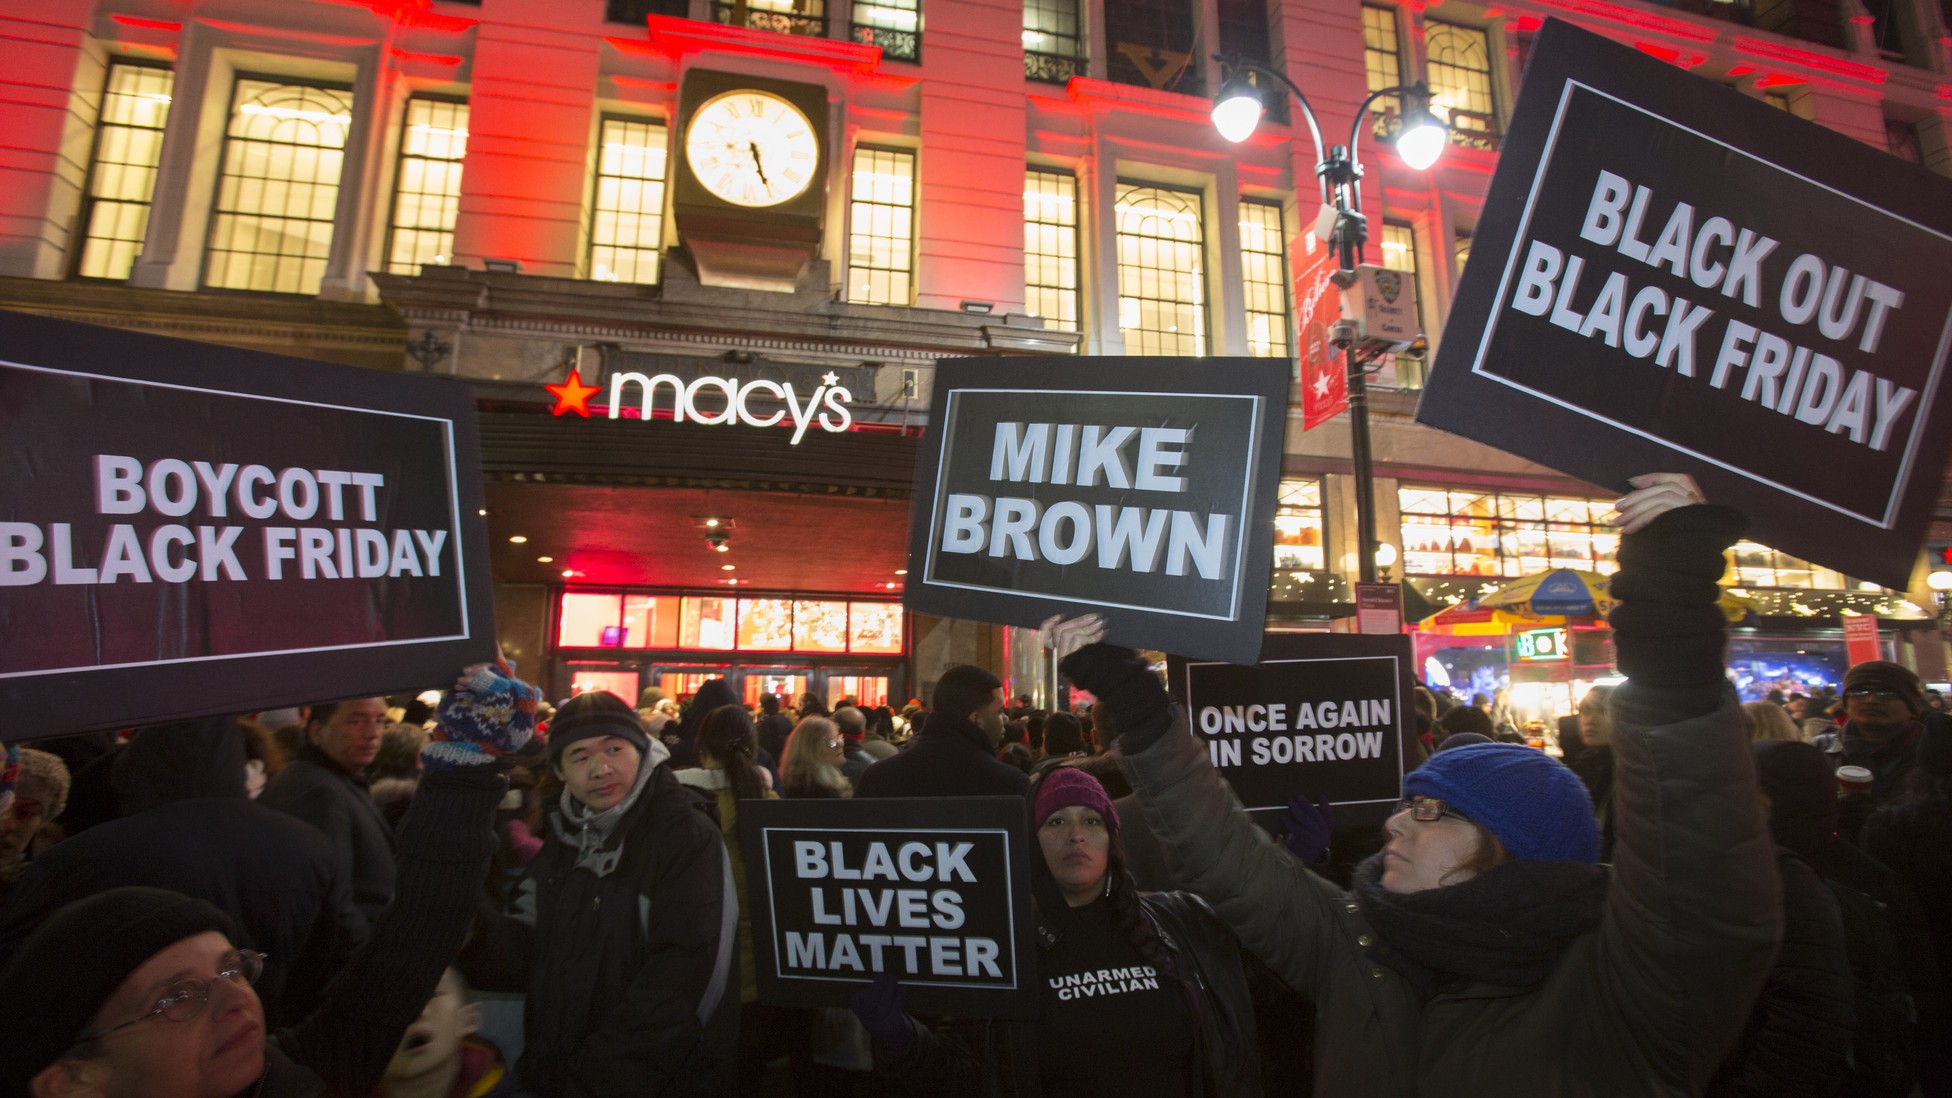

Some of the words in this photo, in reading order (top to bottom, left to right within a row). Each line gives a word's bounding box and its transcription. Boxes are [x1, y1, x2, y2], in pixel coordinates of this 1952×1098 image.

[1580, 169, 1780, 308] BLACK
[1779, 253, 1905, 353] OUT
[1512, 240, 1714, 378] BLACK
[1709, 319, 1917, 451] FRIDAY
[989, 421, 1192, 492] MIKE
[93, 454, 384, 522] BOYCOTT
[0, 521, 248, 586] BLACK
[262, 526, 448, 580] FRIDAY
[941, 493, 1230, 580] BROWN
[1200, 704, 1287, 735] ONCE
[1295, 699, 1391, 730] AGAIN
[1210, 739, 1242, 767] IN
[1251, 732, 1383, 765] SORROW
[794, 841, 977, 882] BLACK
[810, 887, 965, 929] LIVES
[786, 931, 1002, 978] MATTER
[1049, 966, 1156, 989] UNARMED
[1059, 978, 1159, 1000] CIVILIAN
